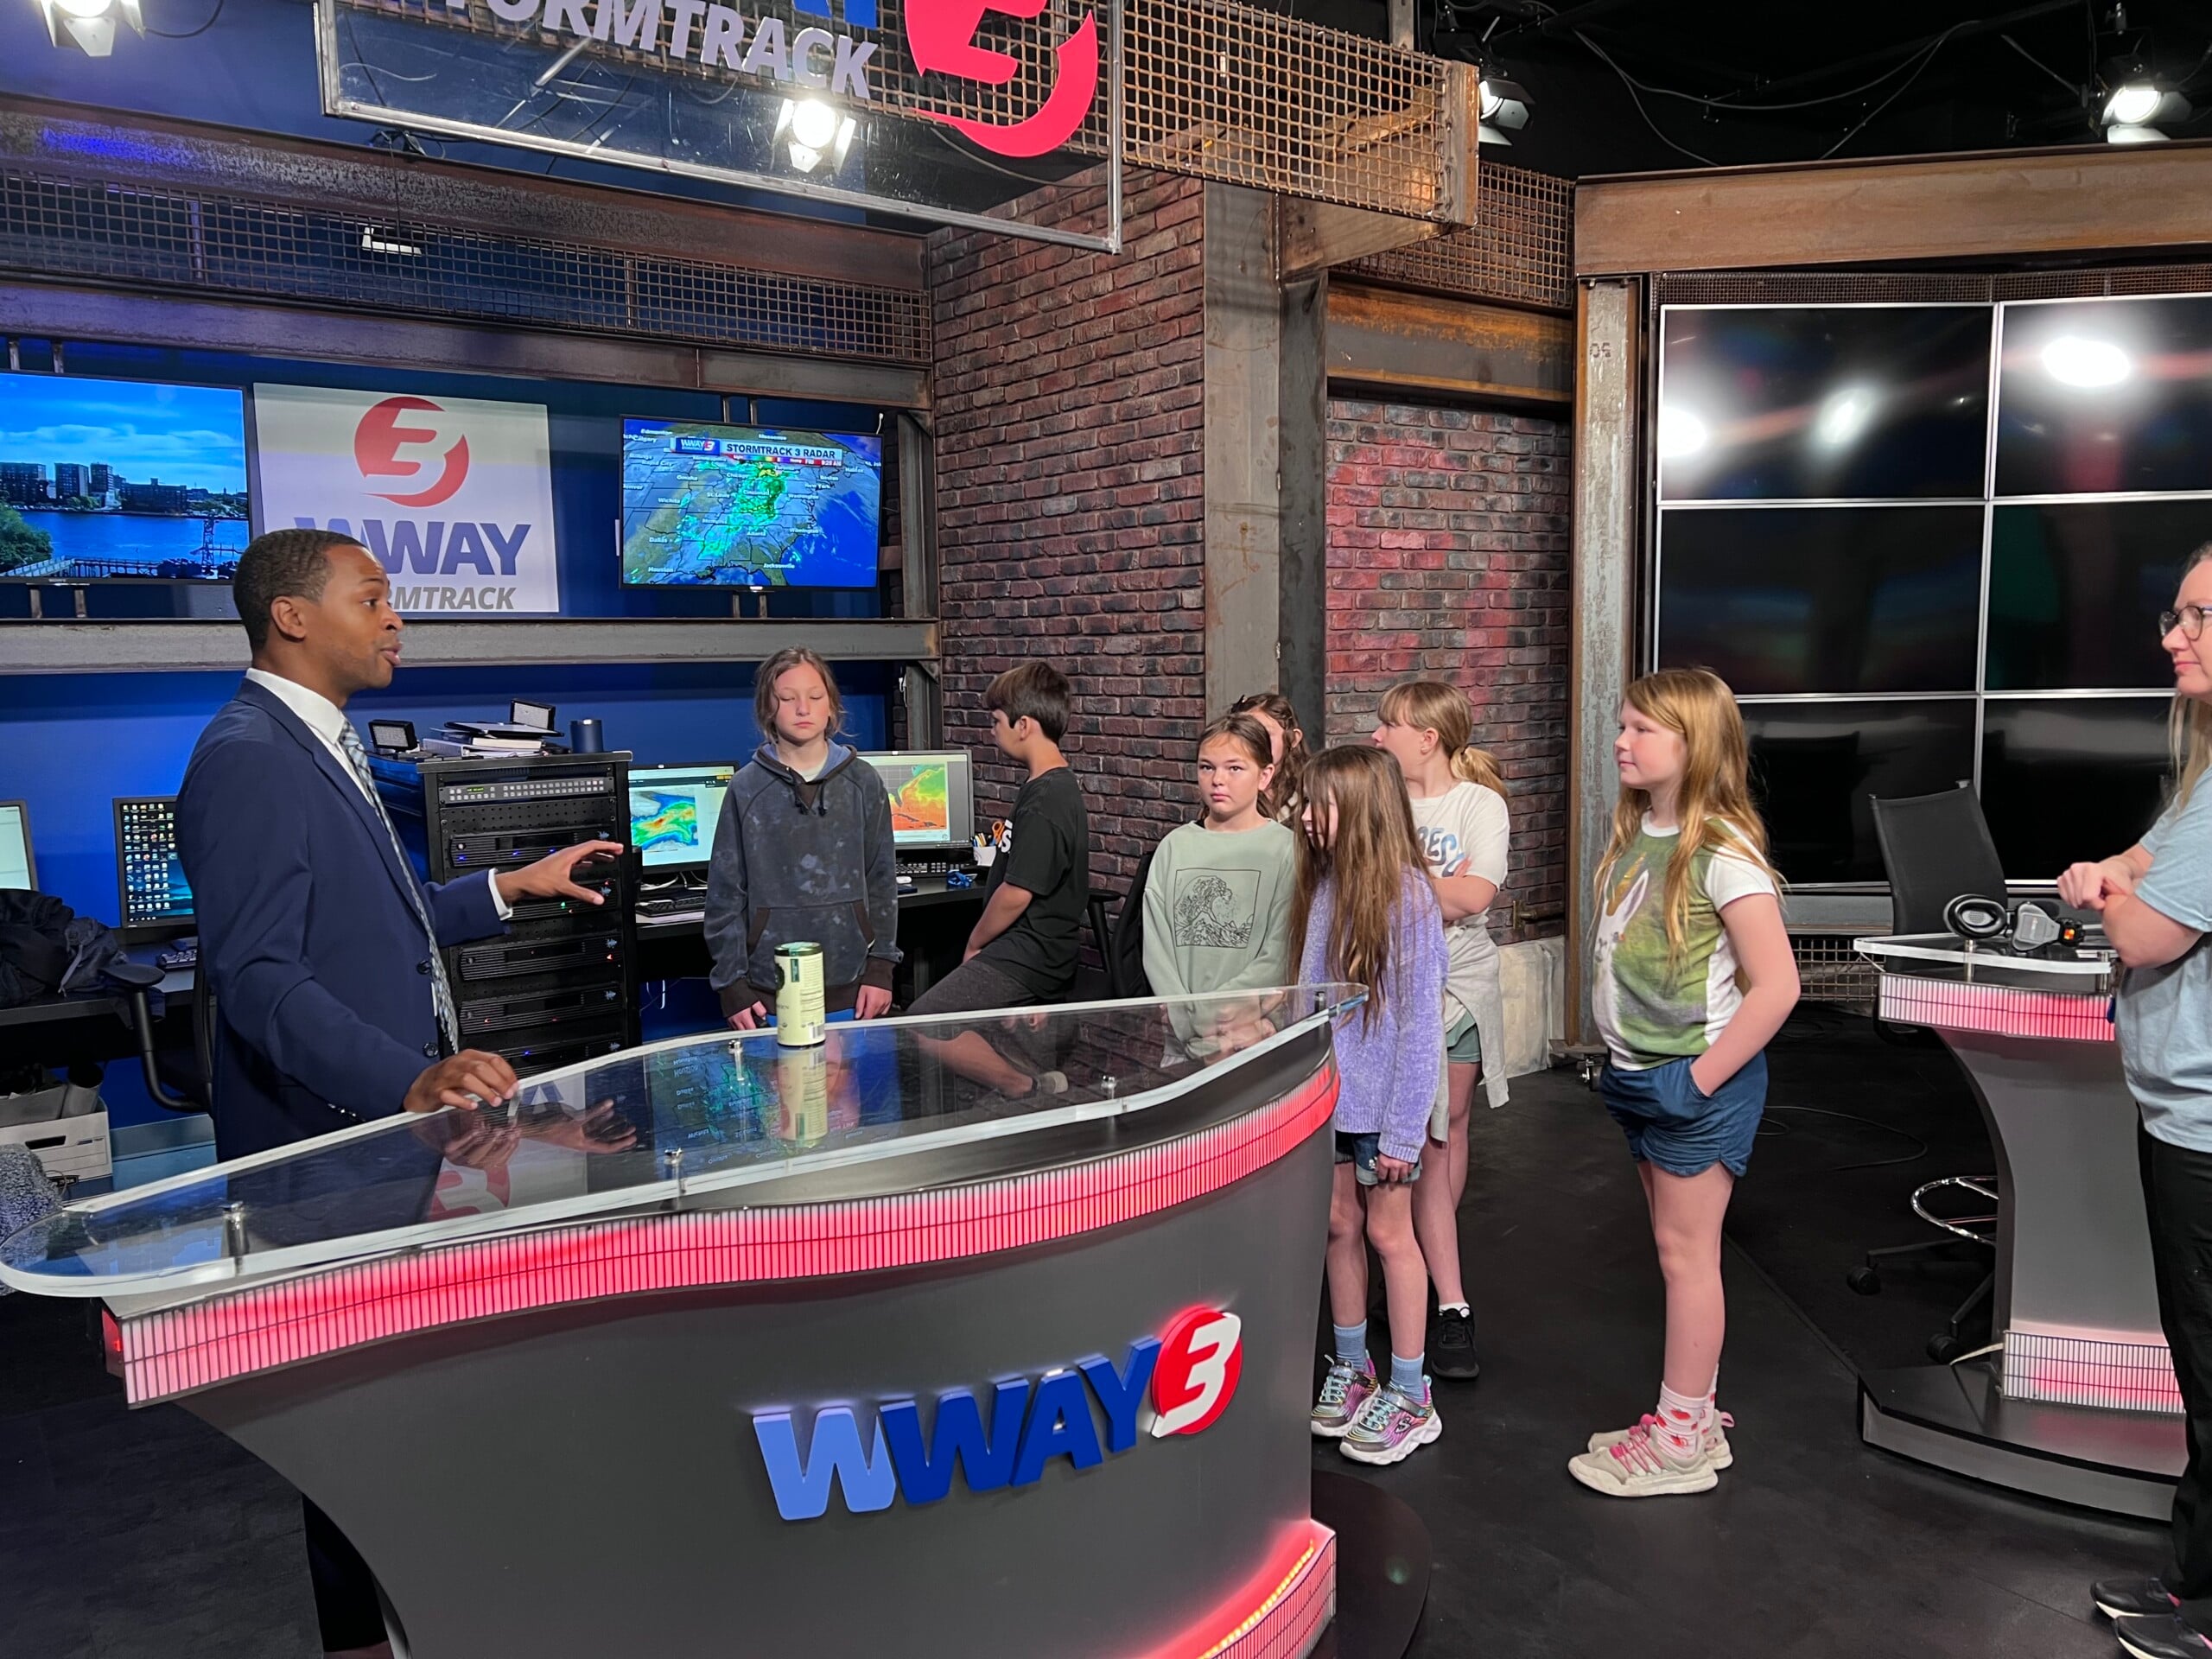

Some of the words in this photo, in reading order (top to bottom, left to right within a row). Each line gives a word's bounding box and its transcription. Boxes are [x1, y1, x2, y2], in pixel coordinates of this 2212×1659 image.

[727, 443, 792, 456] STORMTRACK
[804, 448, 836, 459] RADAR
[753, 1335, 1163, 1521] WWAY
[1151, 1309, 1242, 1439] 3
